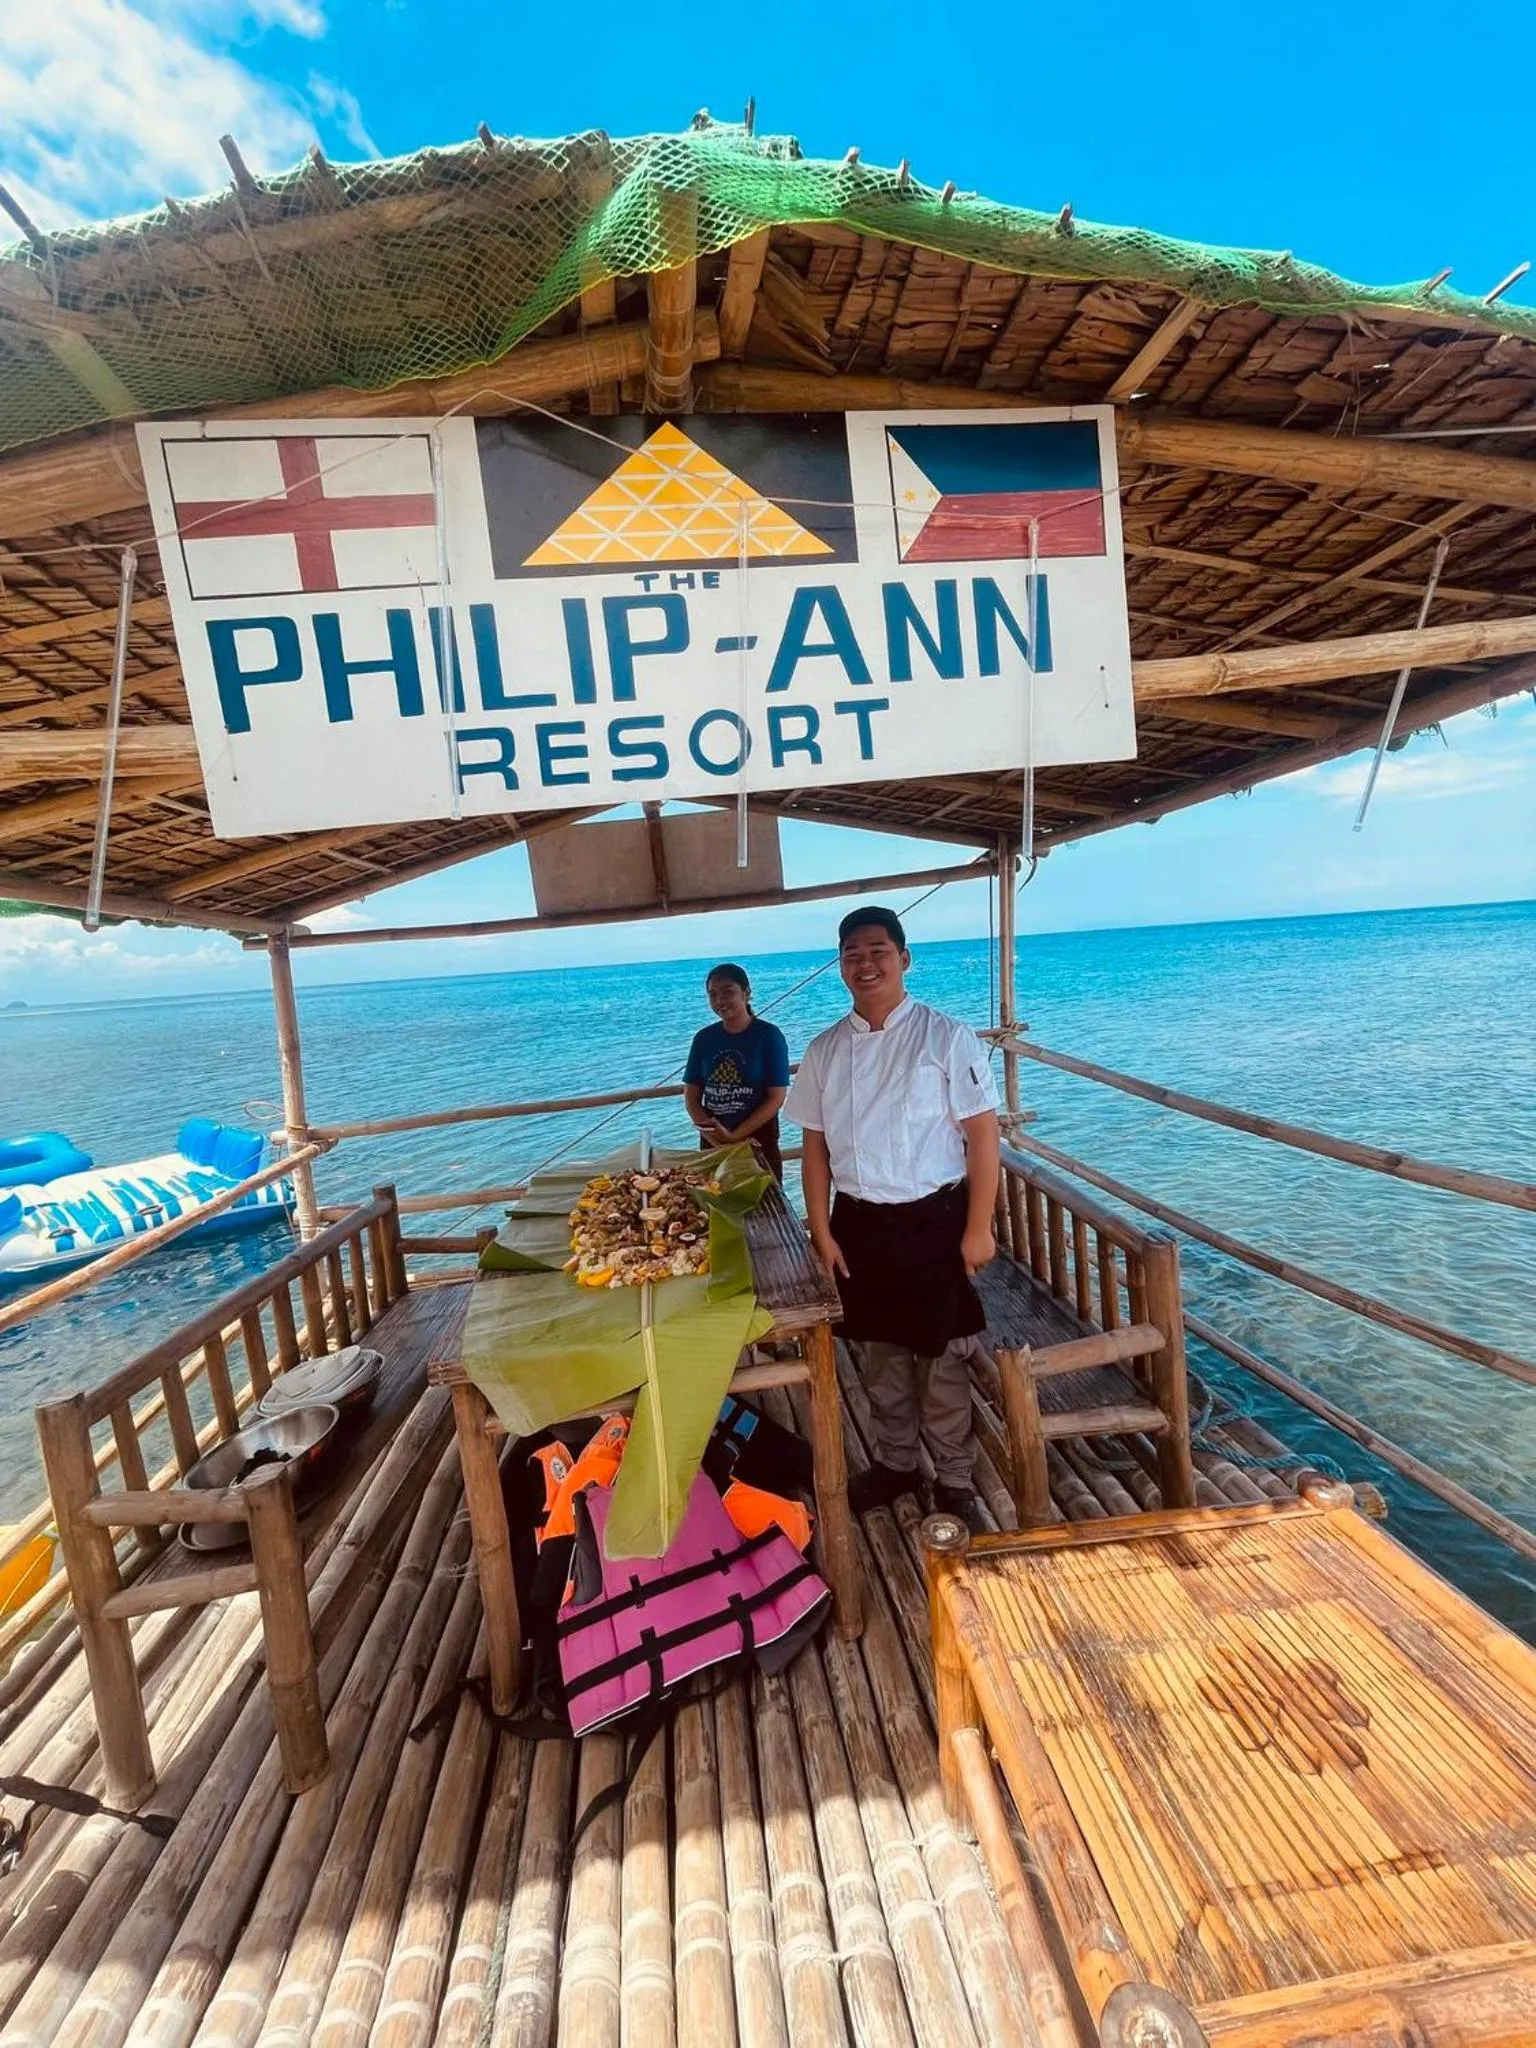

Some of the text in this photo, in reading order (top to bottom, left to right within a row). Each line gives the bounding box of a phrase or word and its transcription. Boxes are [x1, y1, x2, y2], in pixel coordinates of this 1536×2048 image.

[634, 571, 720, 592] THE
[205, 573, 1054, 735] PHILIP-ANN
[444, 698, 889, 796] RESORT
